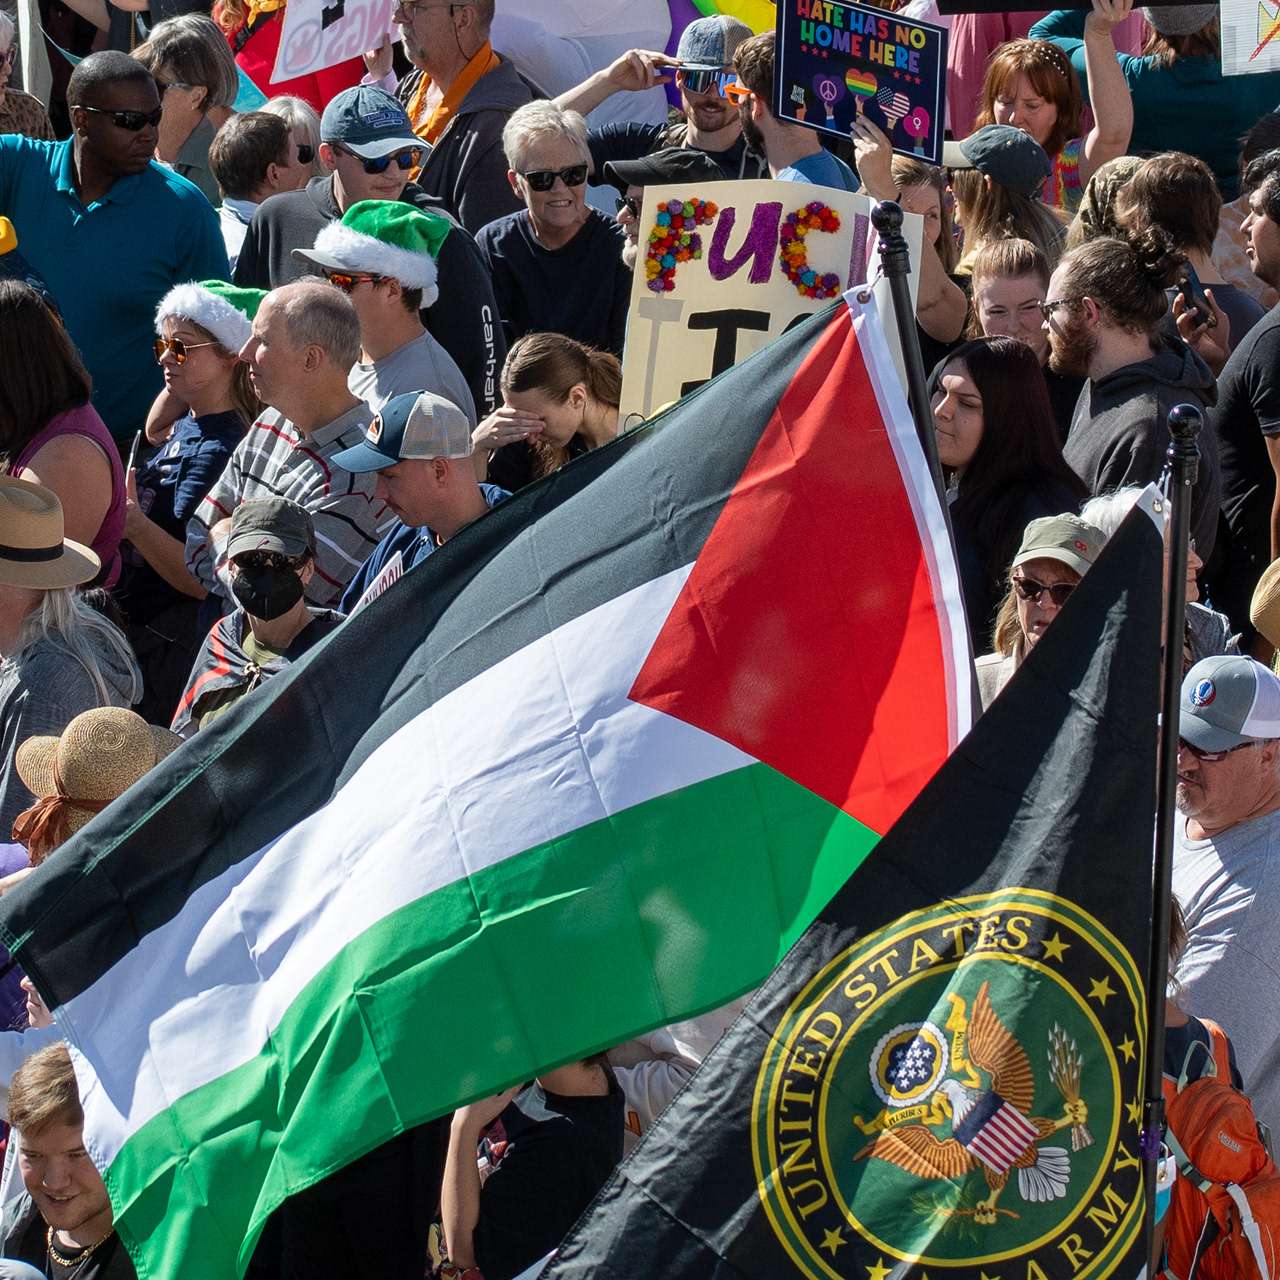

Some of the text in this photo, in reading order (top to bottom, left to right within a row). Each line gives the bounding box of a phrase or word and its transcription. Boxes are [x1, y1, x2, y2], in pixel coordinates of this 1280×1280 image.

[800, 20, 920, 74] HOME HERE
[849, 9, 889, 40] HAS
[894, 24, 925, 49] NO
[774, 913, 1033, 1213] UNITED STATES
